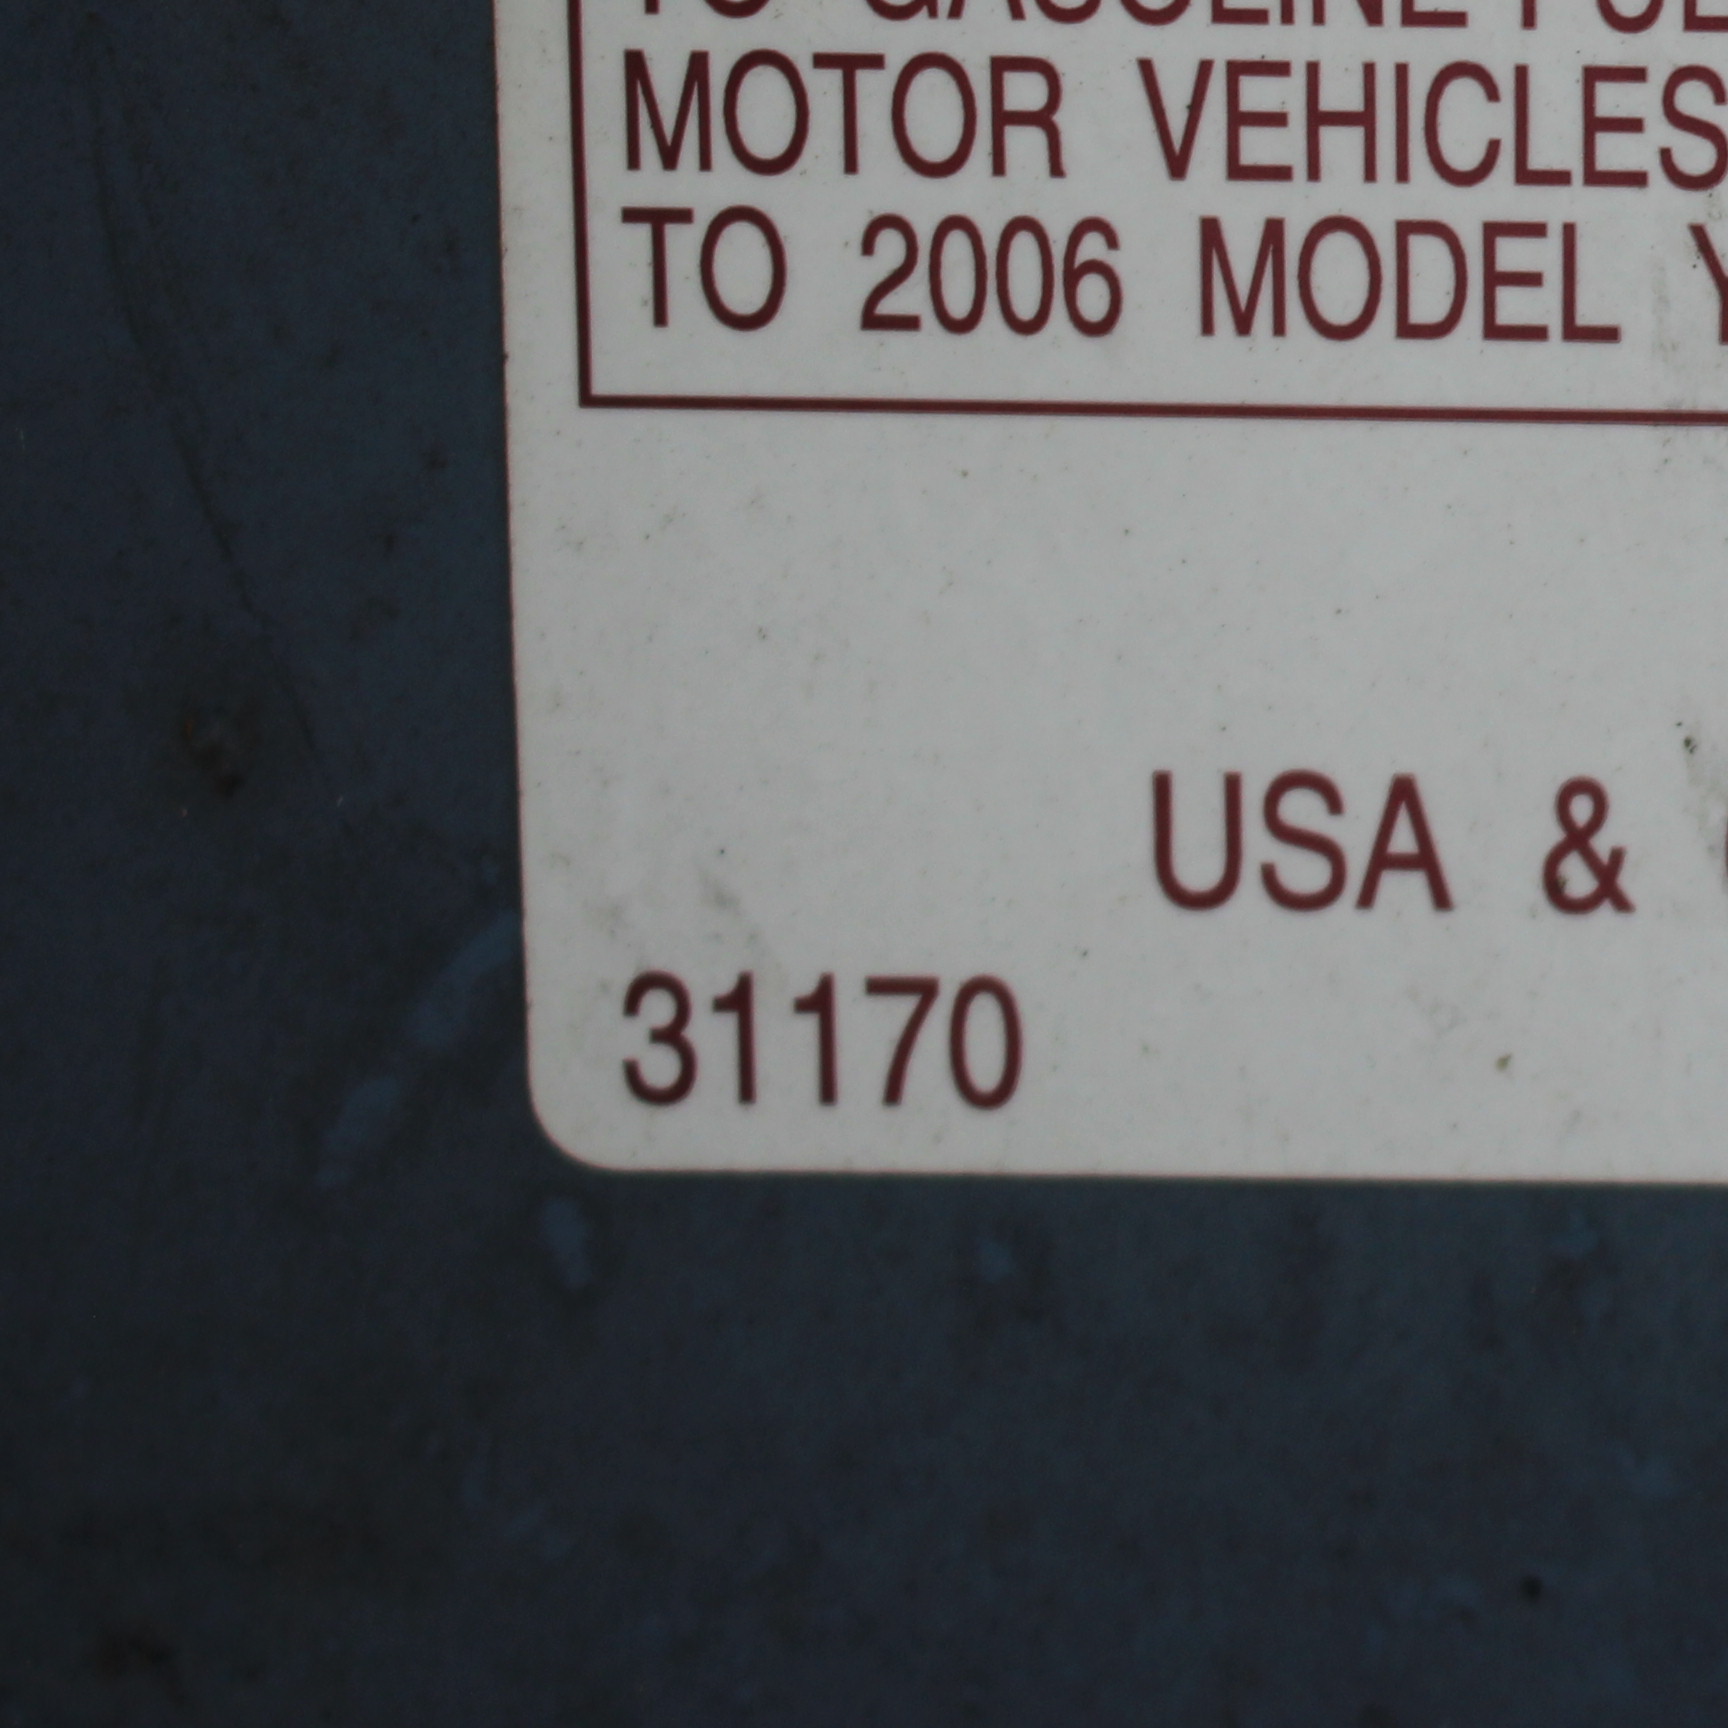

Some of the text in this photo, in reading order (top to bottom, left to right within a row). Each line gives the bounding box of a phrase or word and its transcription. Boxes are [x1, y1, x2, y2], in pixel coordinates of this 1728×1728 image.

[624, 49, 1066, 179] MOTOR
[621, 205, 787, 332] TO
[860, 213, 1123, 338] 2006
[1199, 215, 1621, 344] MODEL
[1152, 770, 1454, 913] USA
[1542, 777, 1635, 915] &
[623, 970, 1023, 1111] 31170
